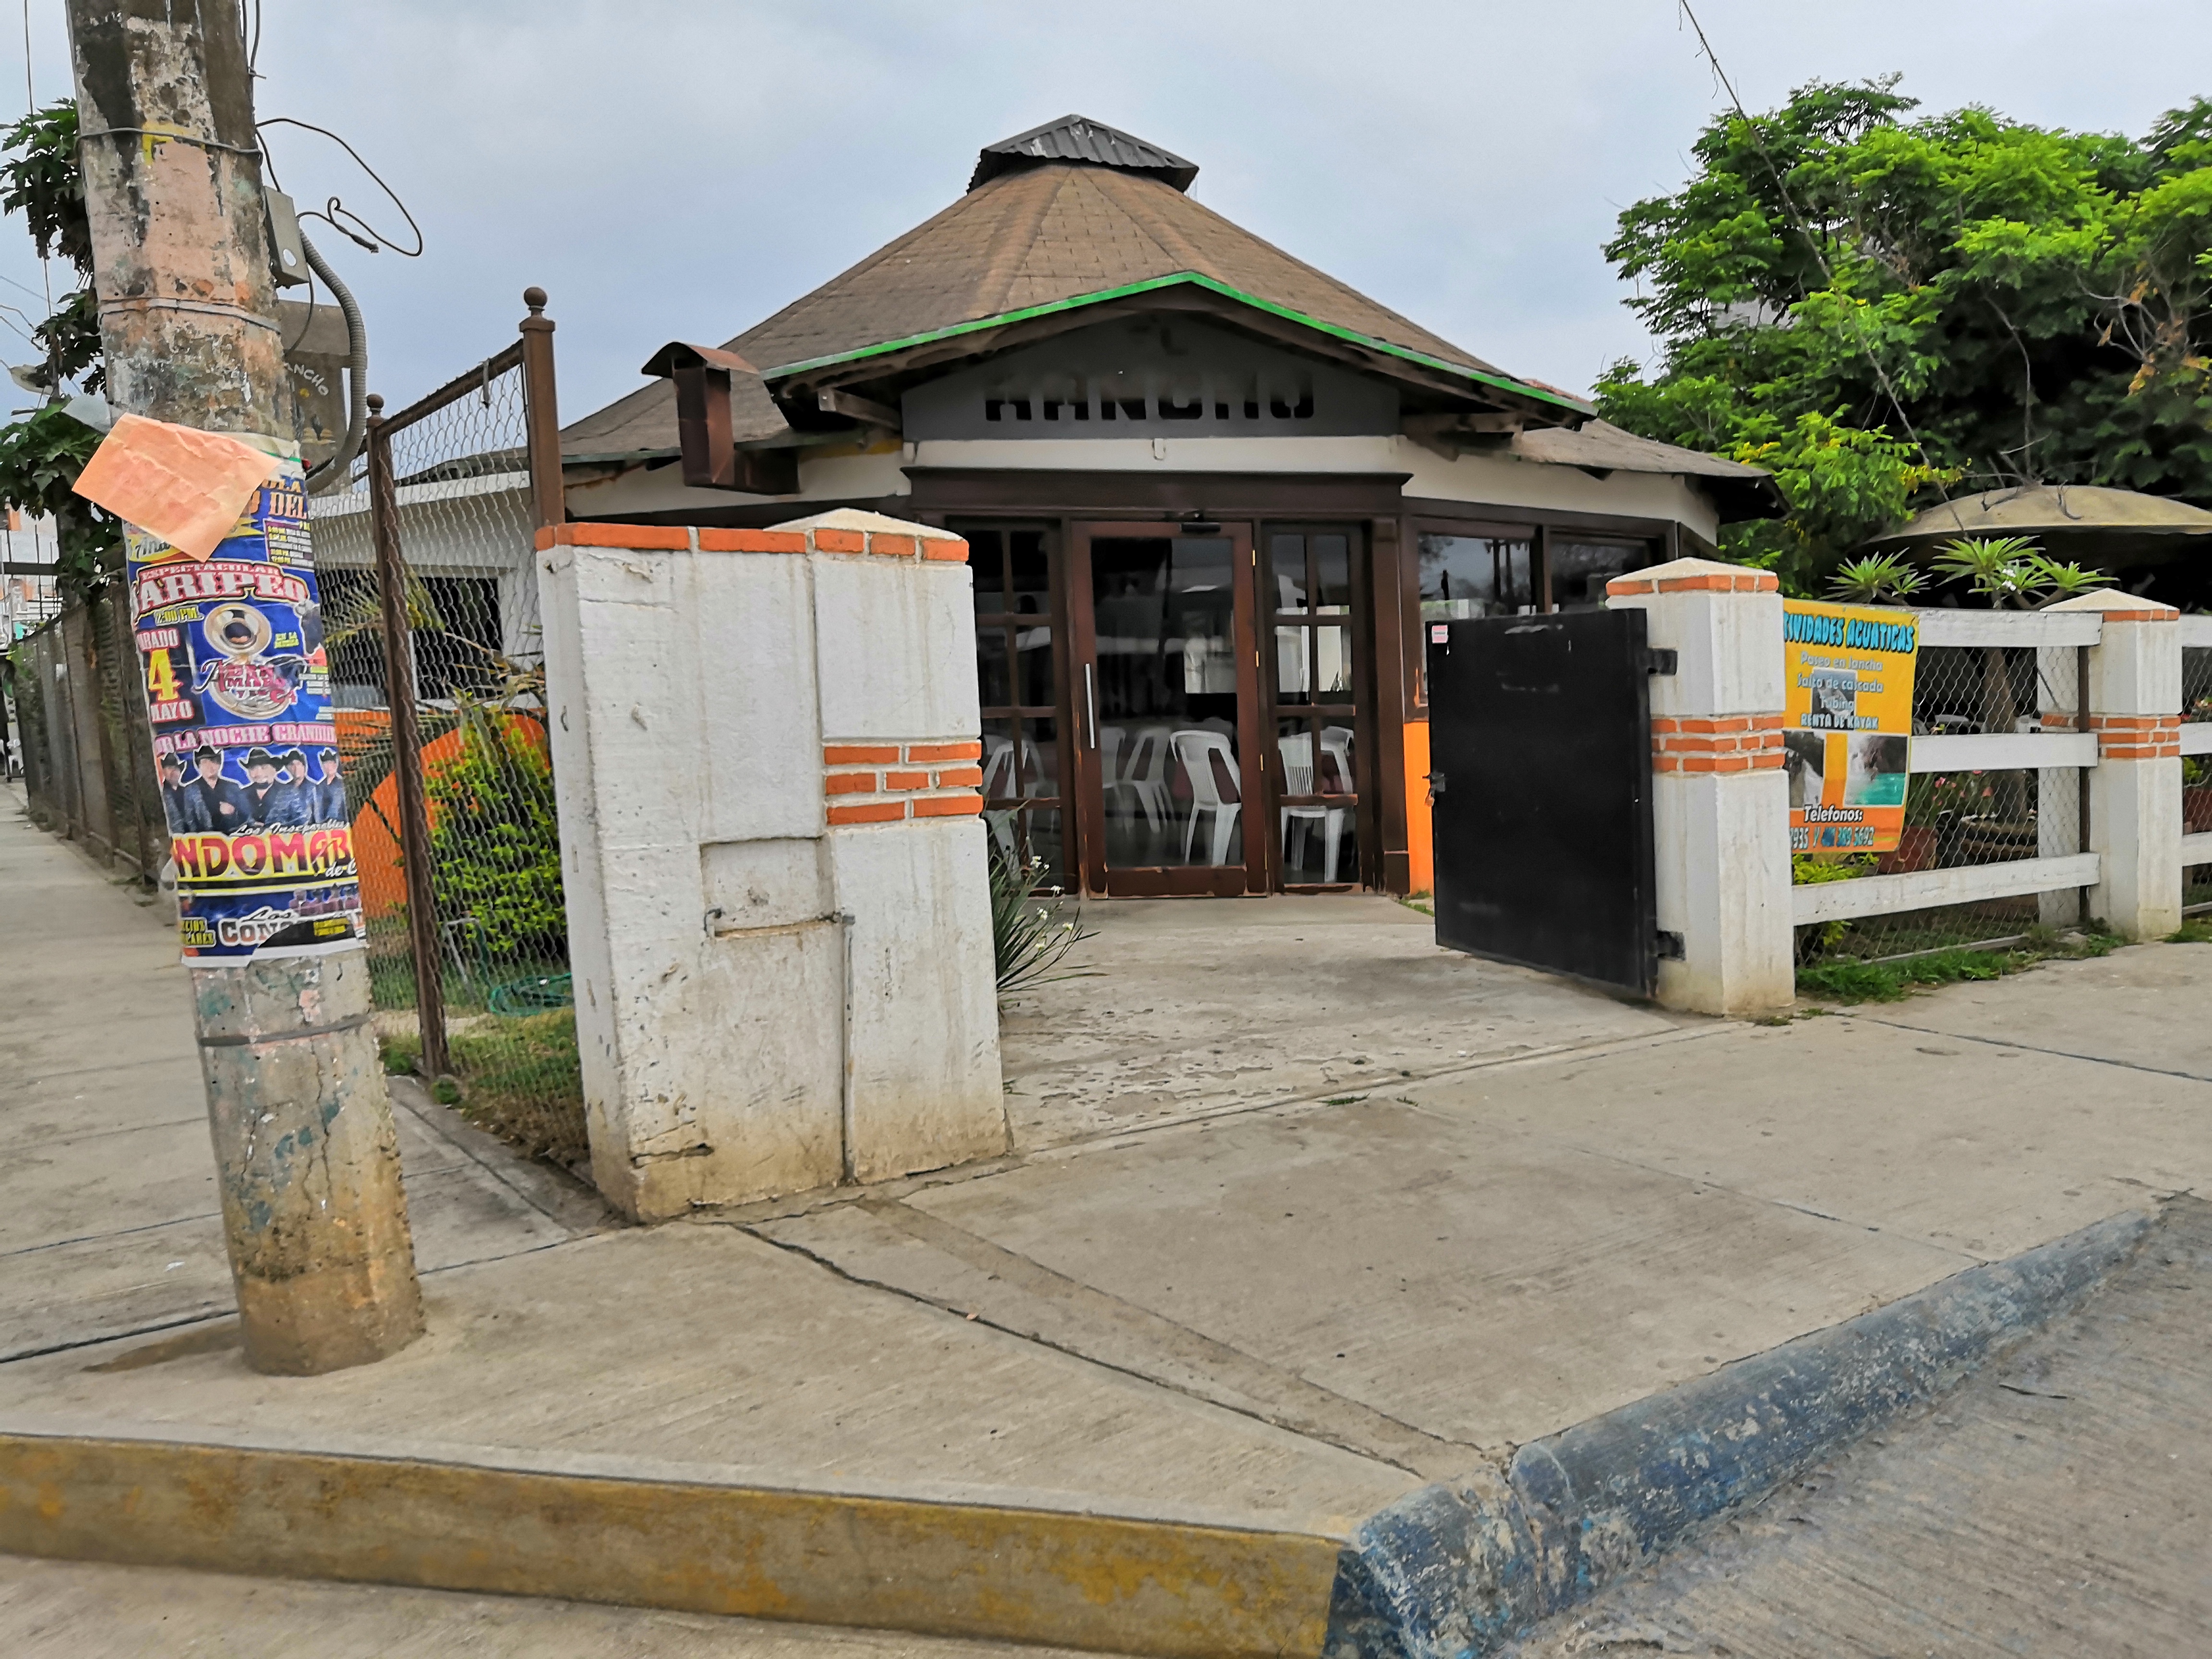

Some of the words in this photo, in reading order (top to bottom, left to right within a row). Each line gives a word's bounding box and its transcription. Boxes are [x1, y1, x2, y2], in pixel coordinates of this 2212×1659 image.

[268, 491, 307, 519] DEL
[1846, 618, 1915, 654] ACUATICAS
[1801, 650, 1831, 668] Paseo
[1833, 657, 1846, 668] en
[1848, 656, 1883, 671] lancha
[148, 649, 183, 701] 4
[1826, 676, 1839, 689] de
[1841, 679, 1884, 693] cascada
[1801, 713, 1832, 727] RENTA
[1847, 715, 1879, 730] KAYAK
[174, 733, 198, 750] LA
[199, 726, 269, 745] NOCHE
[1804, 805, 1863, 823] Telefonos:
[228, 824, 260, 837] Los
[325, 861, 342, 878] de
[241, 909, 292, 923] Los
